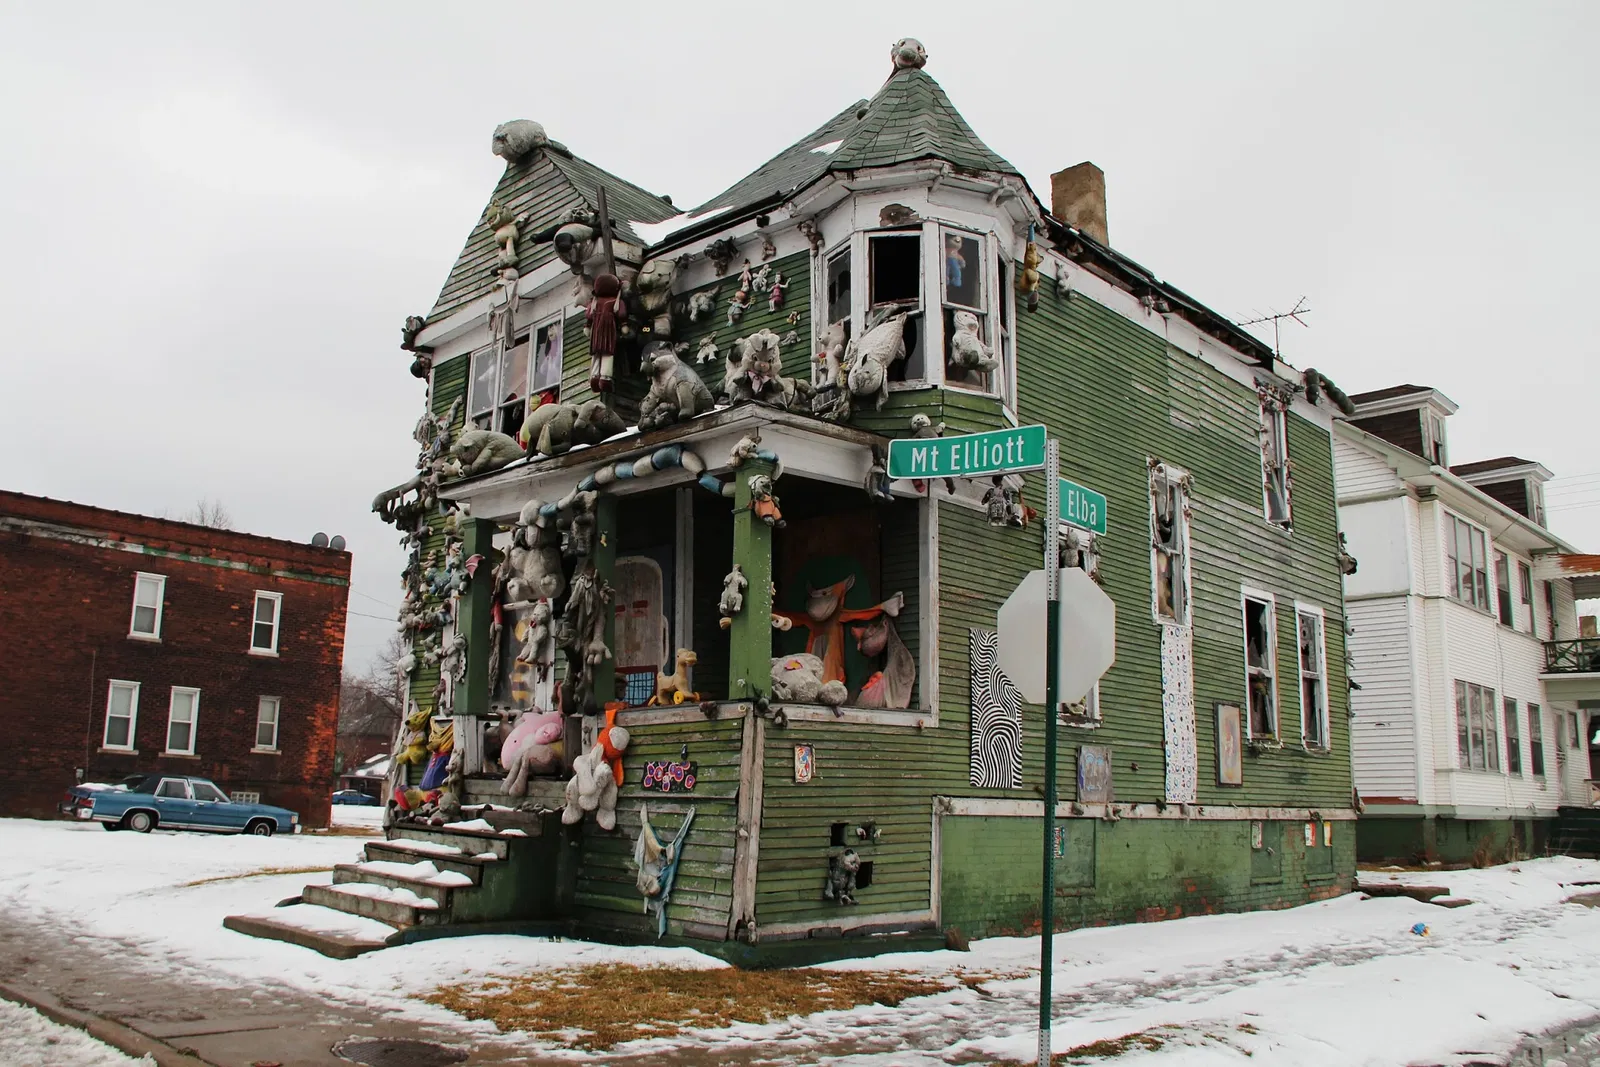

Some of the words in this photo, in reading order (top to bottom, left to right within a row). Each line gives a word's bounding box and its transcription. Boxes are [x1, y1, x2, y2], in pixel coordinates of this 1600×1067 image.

[911, 445, 939, 472] Mt
[951, 435, 1024, 470] Elliott
[1068, 489, 1097, 526] Elba
